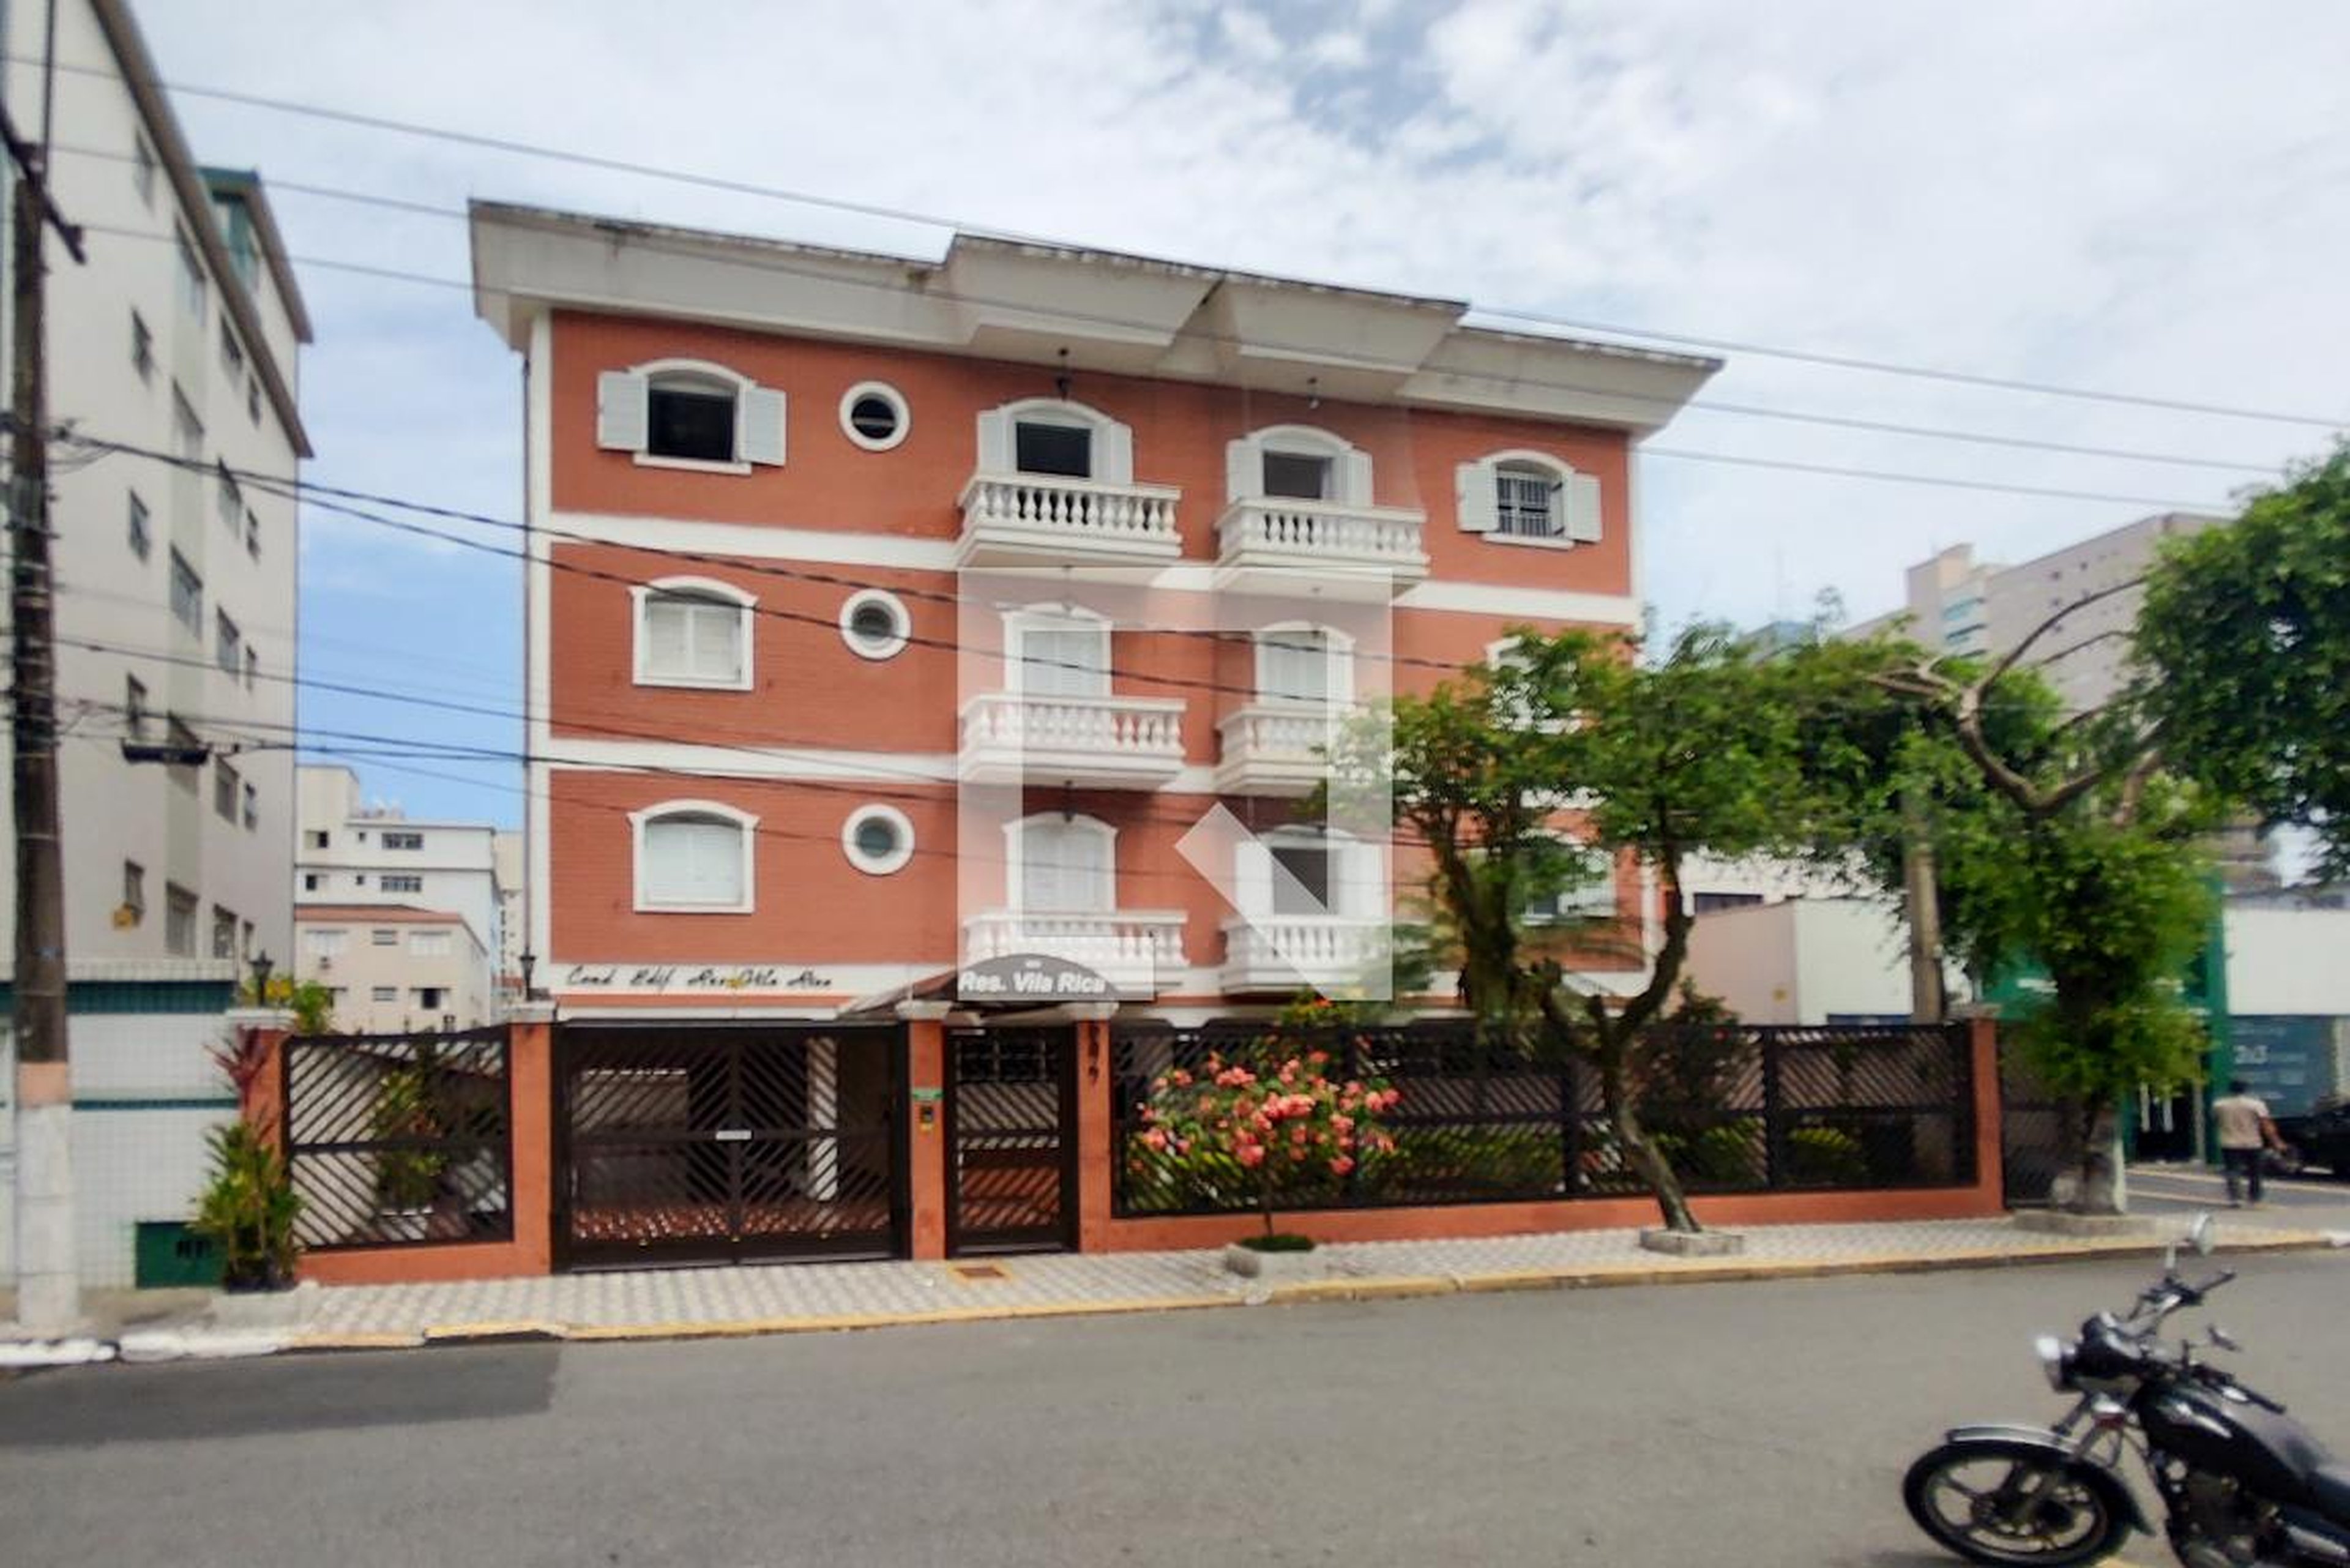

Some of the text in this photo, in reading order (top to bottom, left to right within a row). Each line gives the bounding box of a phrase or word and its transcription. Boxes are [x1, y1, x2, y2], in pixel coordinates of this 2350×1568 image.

[958, 970, 1106, 994] Res. Vila Rica
